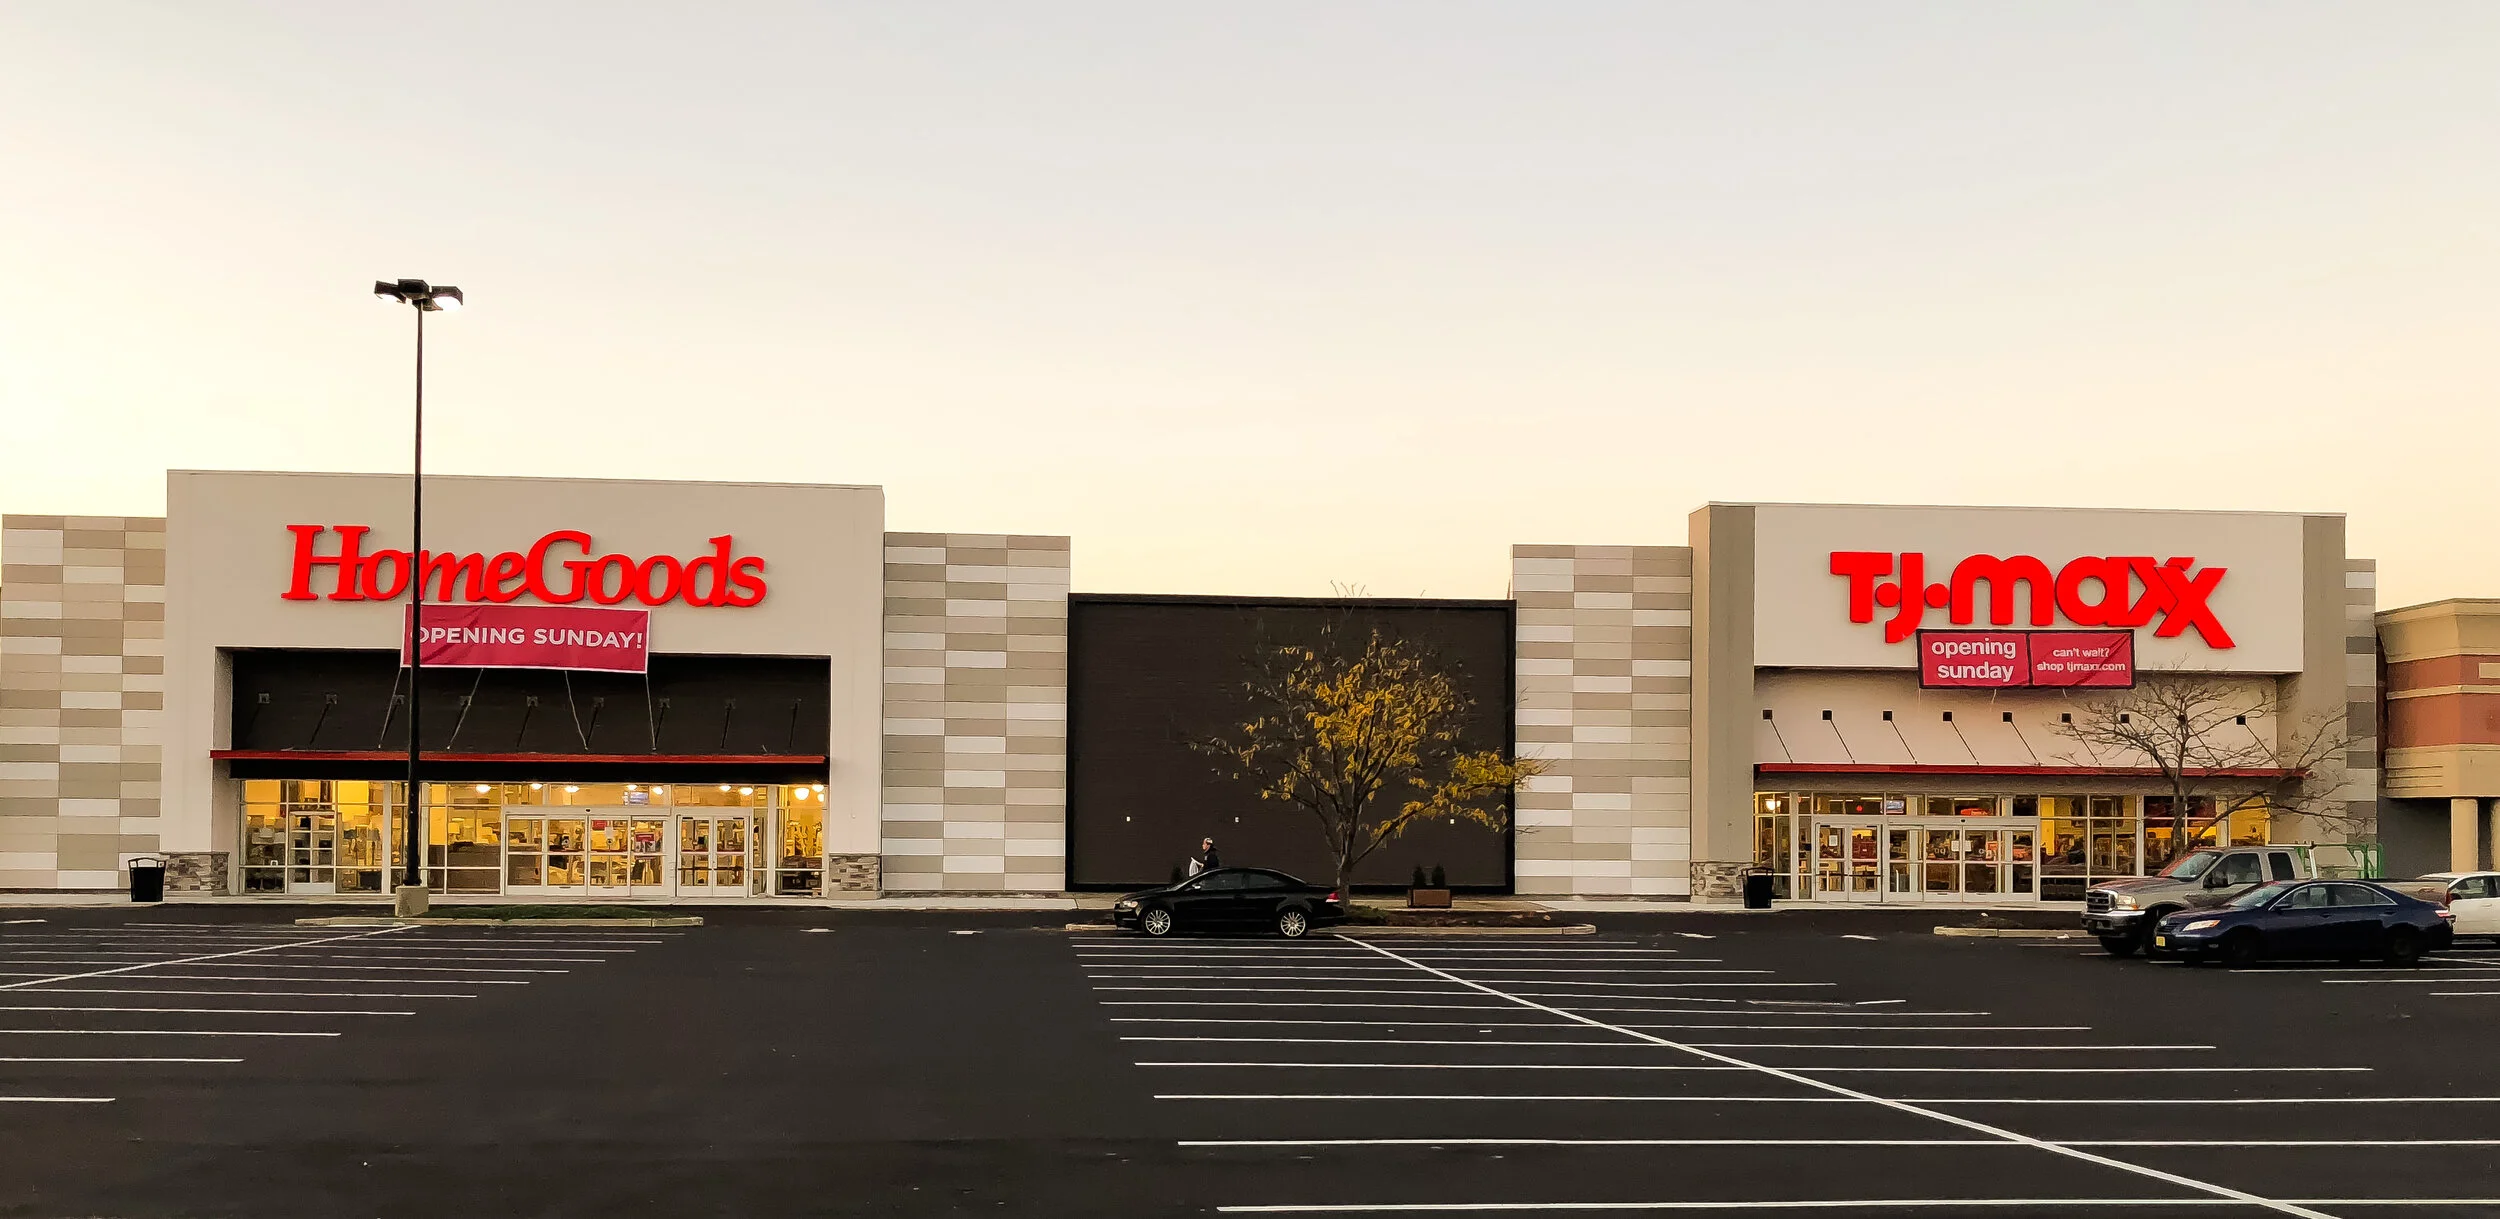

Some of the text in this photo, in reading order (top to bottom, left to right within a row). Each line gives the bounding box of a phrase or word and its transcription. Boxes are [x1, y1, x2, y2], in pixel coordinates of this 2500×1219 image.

[281, 524, 768, 608] HomeGoods
[411, 626, 643, 649] OPENING SUNDAY!
[1931, 637, 2016, 660] opening
[2052, 647, 2110, 658] can't wait?
[1937, 661, 2014, 683] sunday
[2036, 661, 2126, 673] shop tjmaxx.com
